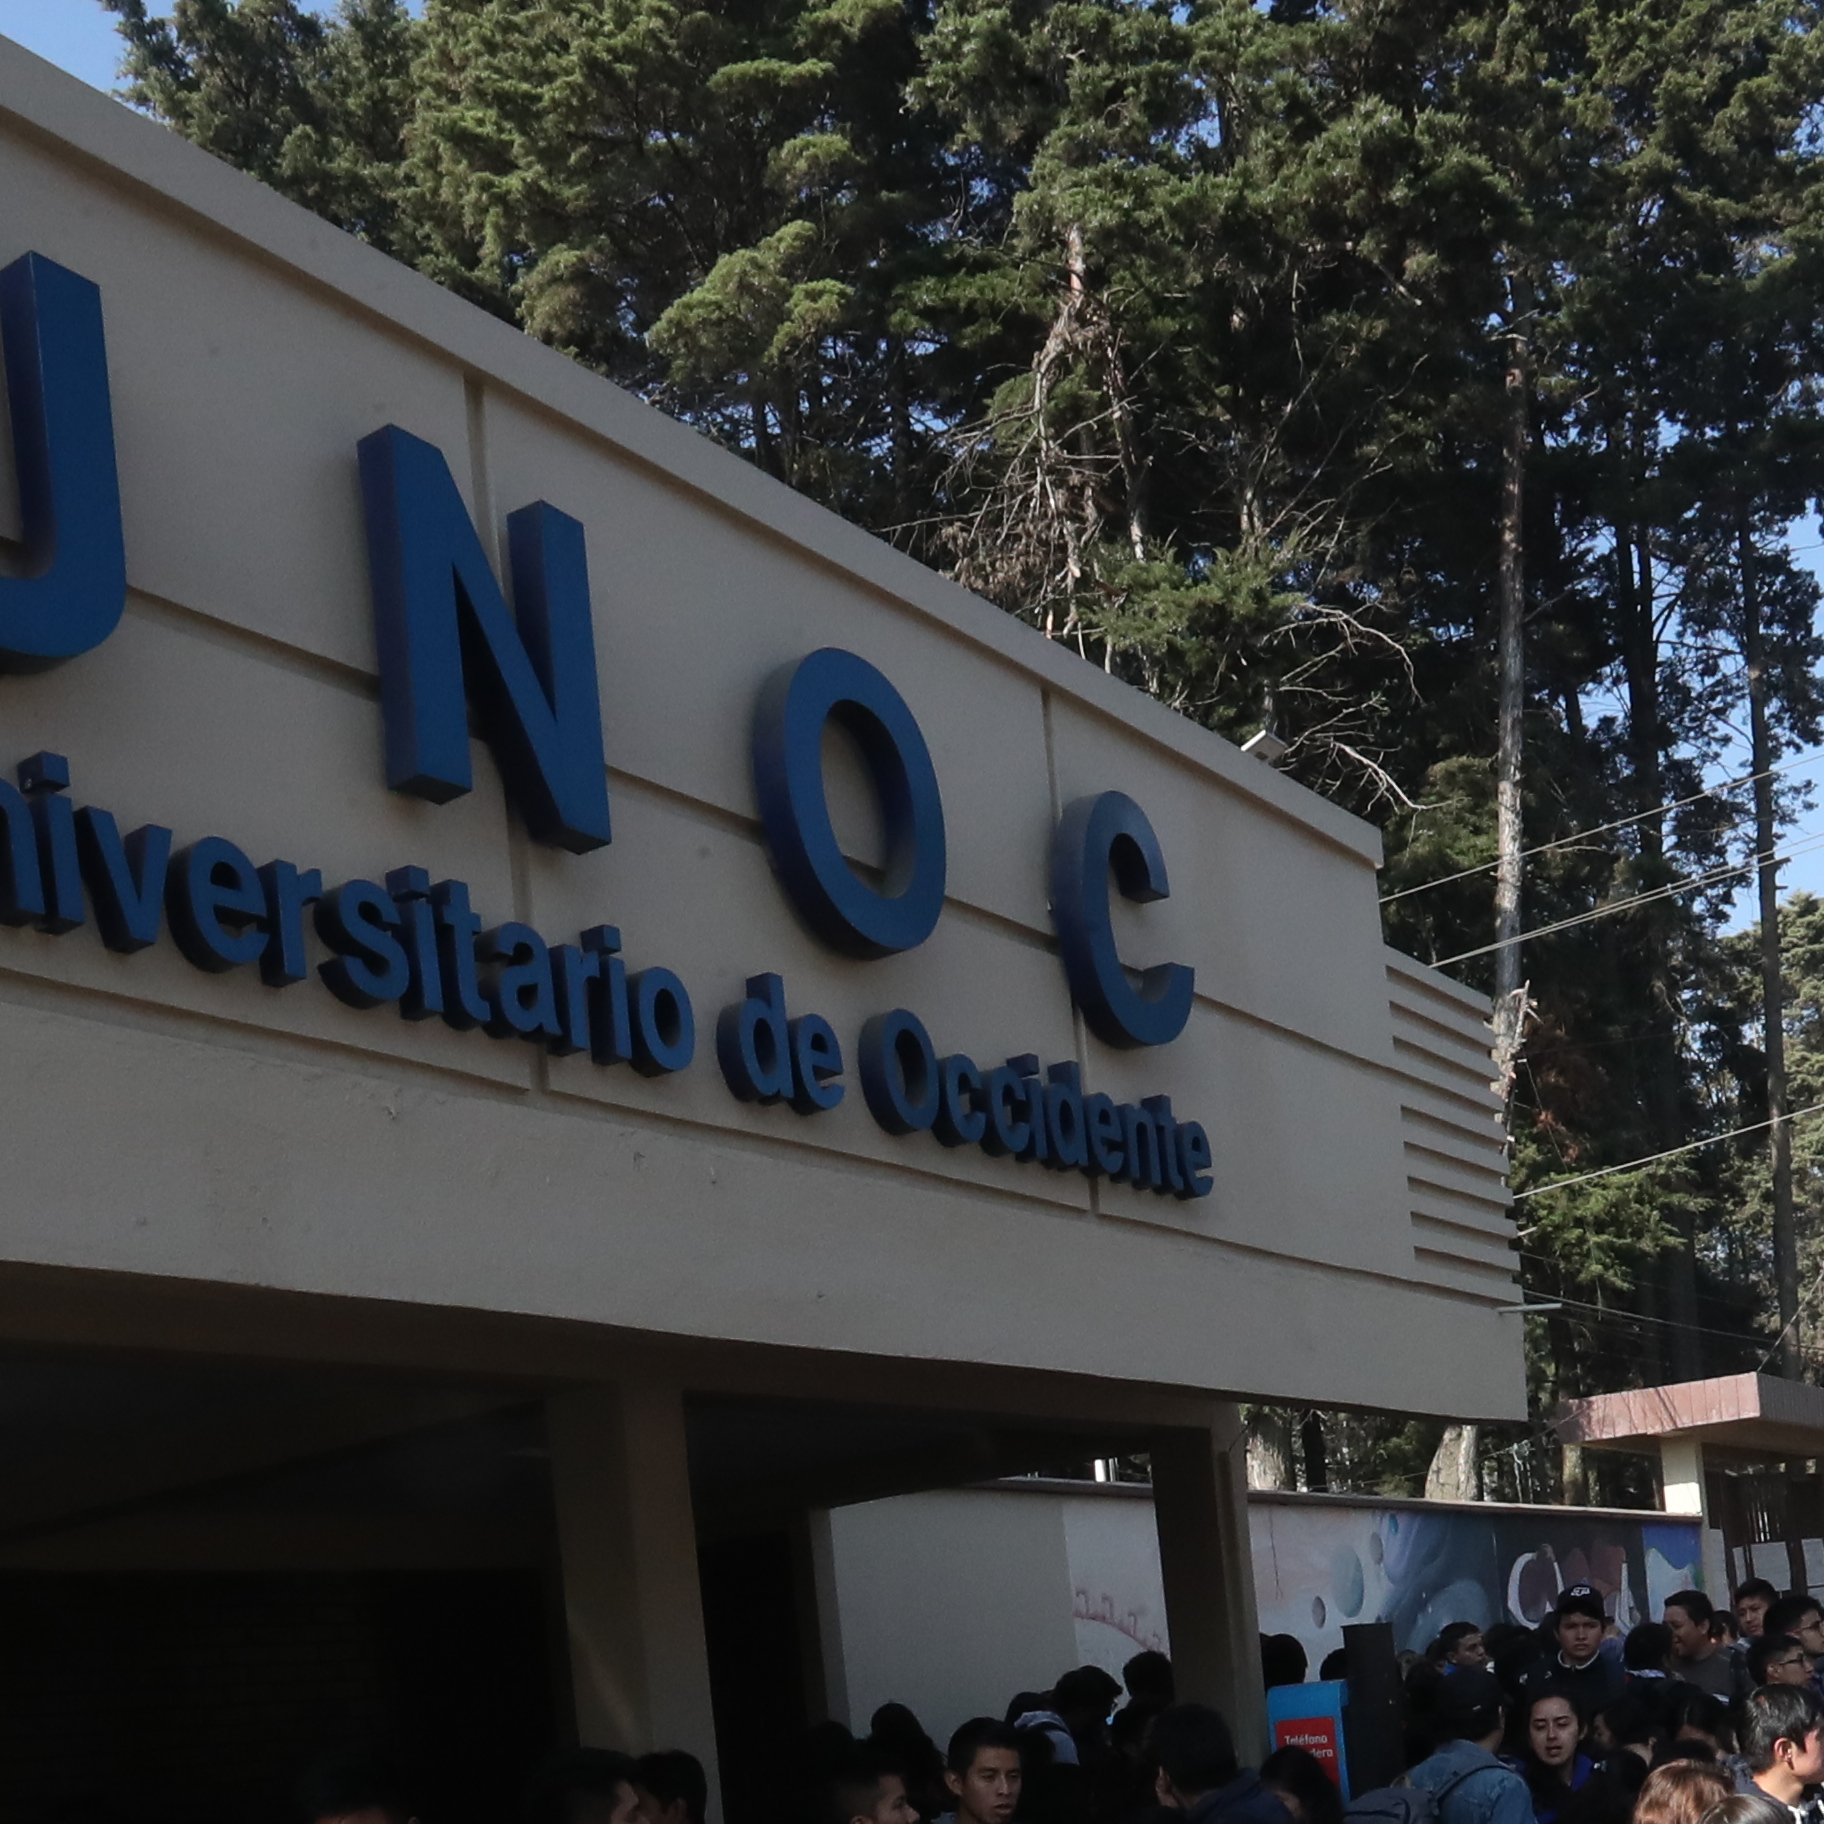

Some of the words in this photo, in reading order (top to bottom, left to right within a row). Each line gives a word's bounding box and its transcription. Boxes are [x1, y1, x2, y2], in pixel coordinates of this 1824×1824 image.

[717, 971, 845, 1112] de
[859, 1008, 1214, 1200] Occidente
[1284, 1733, 1328, 1746] Teléfono
